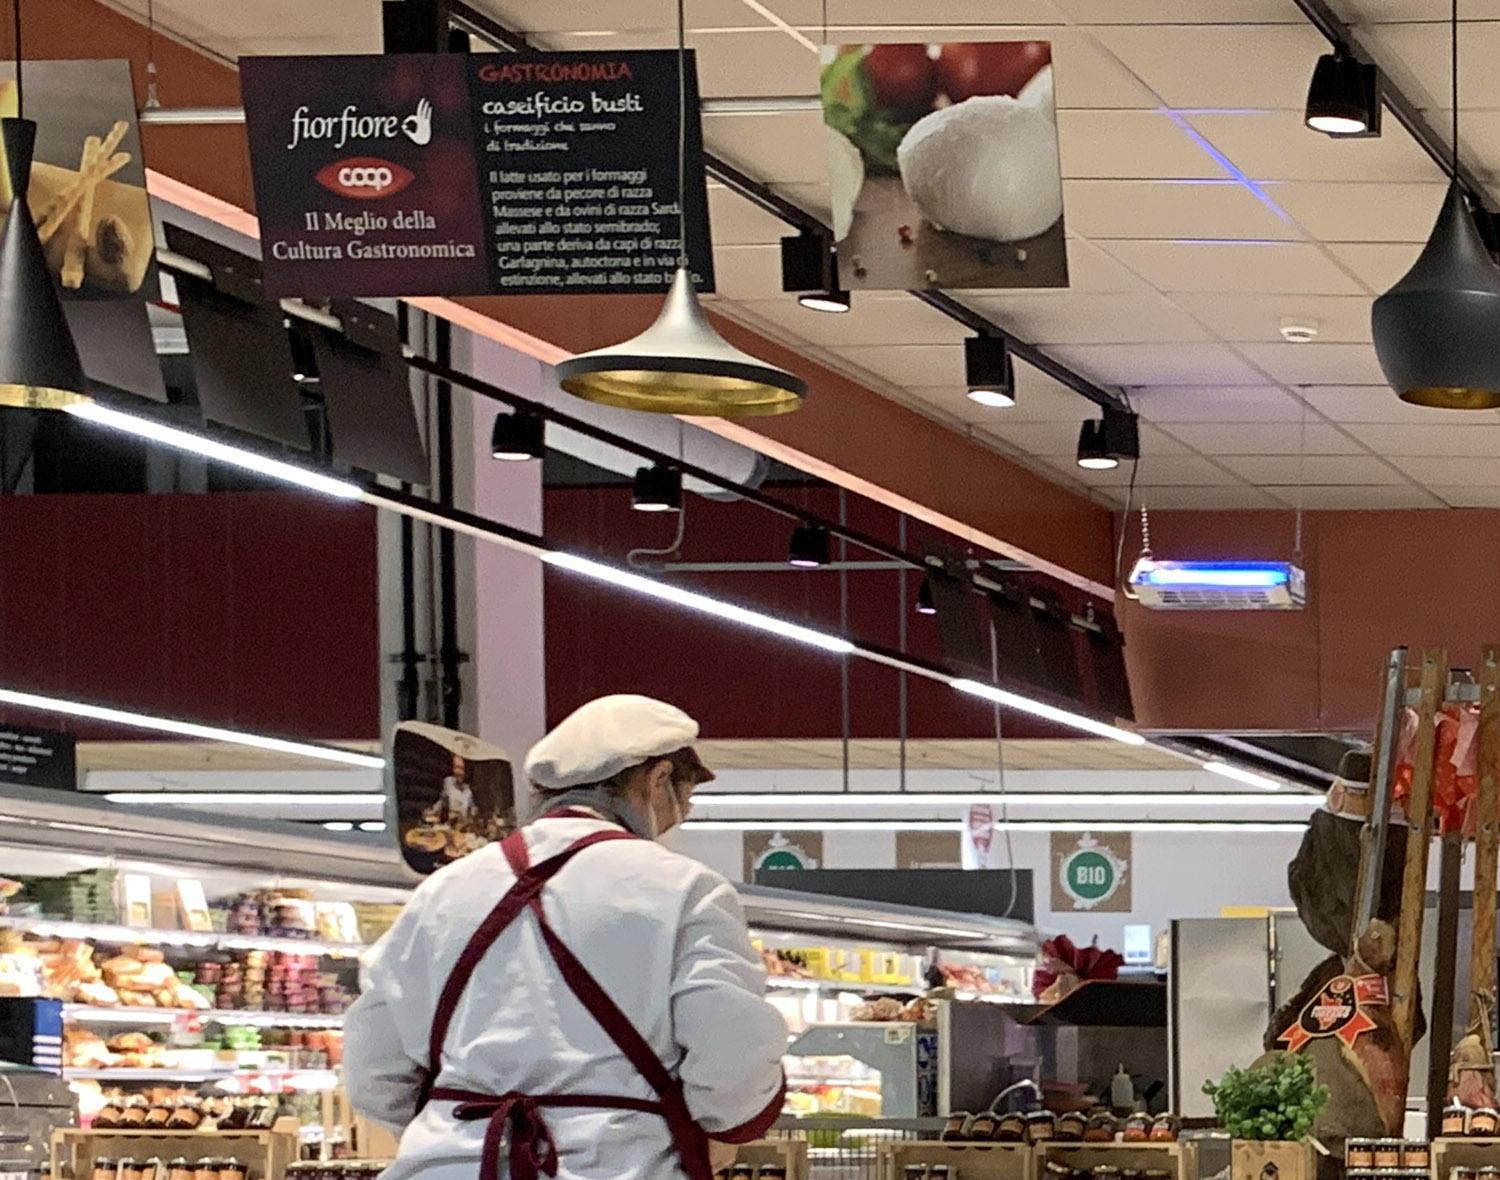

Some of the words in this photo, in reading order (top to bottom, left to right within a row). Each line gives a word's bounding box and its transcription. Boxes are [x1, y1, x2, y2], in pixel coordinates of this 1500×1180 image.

[478, 62, 633, 82] GASTRONOMIA
[482, 91, 585, 119] caseificio
[591, 91, 644, 114] busti
[493, 120, 550, 136] formaggi
[499, 170, 526, 182] latte
[528, 170, 561, 182] usato
[563, 171, 584, 185] per
[591, 168, 647, 185] formaggi
[491, 189, 543, 203] proviene
[545, 187, 562, 199] da
[564, 188, 605, 202] pecore
[606, 186, 619, 198] di
[621, 187, 653, 198] razza
[545, 208, 553, 217] e
[555, 205, 571, 217] da
[603, 203, 617, 216] di
[618, 205, 650, 216] razza
[305, 211, 319, 231] Il
[324, 211, 388, 235] Meglio
[393, 210, 437, 230] della
[562, 222, 592, 234] stato
[272, 241, 343, 260] Cultura
[347, 240, 476, 260] Gastronomica
[497, 241, 521, 252] una
[523, 240, 554, 254] parte
[556, 239, 593, 251] deriva
[595, 239, 611, 251] da
[612, 239, 638, 253] capi
[639, 238, 652, 249] di
[633, 257, 642, 268] e
[657, 255, 675, 267] via
[609, 272, 631, 285] allo
[633, 272, 662, 284] stato
[1076, 865, 1106, 885] BIO
